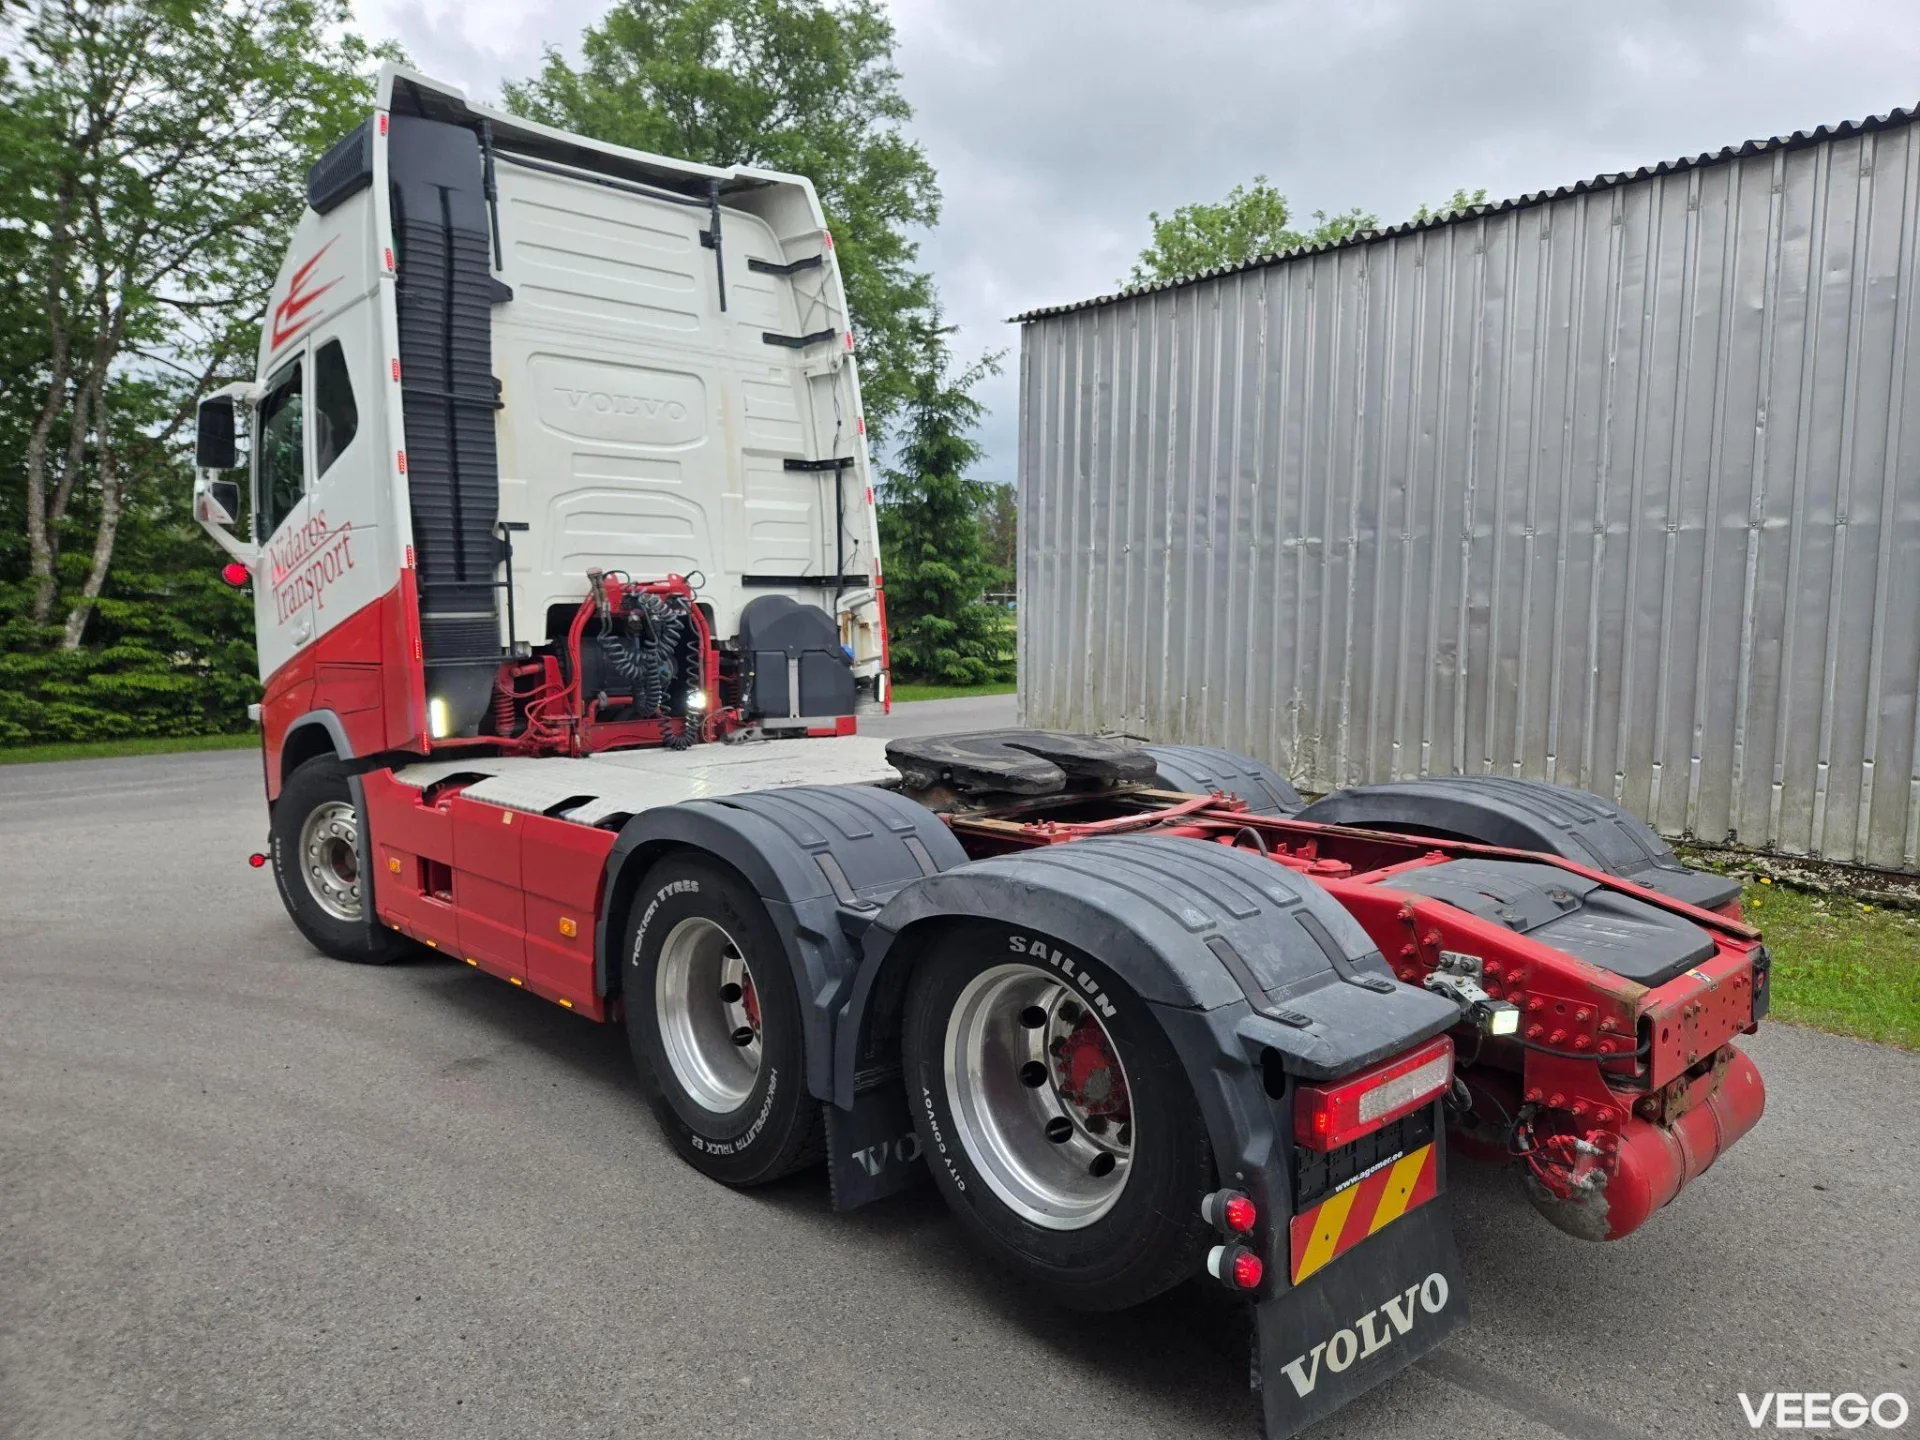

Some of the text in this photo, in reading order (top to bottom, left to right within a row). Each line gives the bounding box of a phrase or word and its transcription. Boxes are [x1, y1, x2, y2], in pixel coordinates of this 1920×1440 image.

[553, 387, 687, 421] VOLVO
[269, 509, 327, 586] Nidaros
[272, 525, 354, 626] Transport
[657, 880, 699, 901] TYRES
[1009, 936, 1117, 1018] SAILUN
[706, 1142, 734, 1155] TRUCK
[922, 1087, 966, 1191] CITY CONVOY
[1335, 1150, 1403, 1192] www.agomer.ee
[1281, 1273, 1449, 1398] VOLVO
